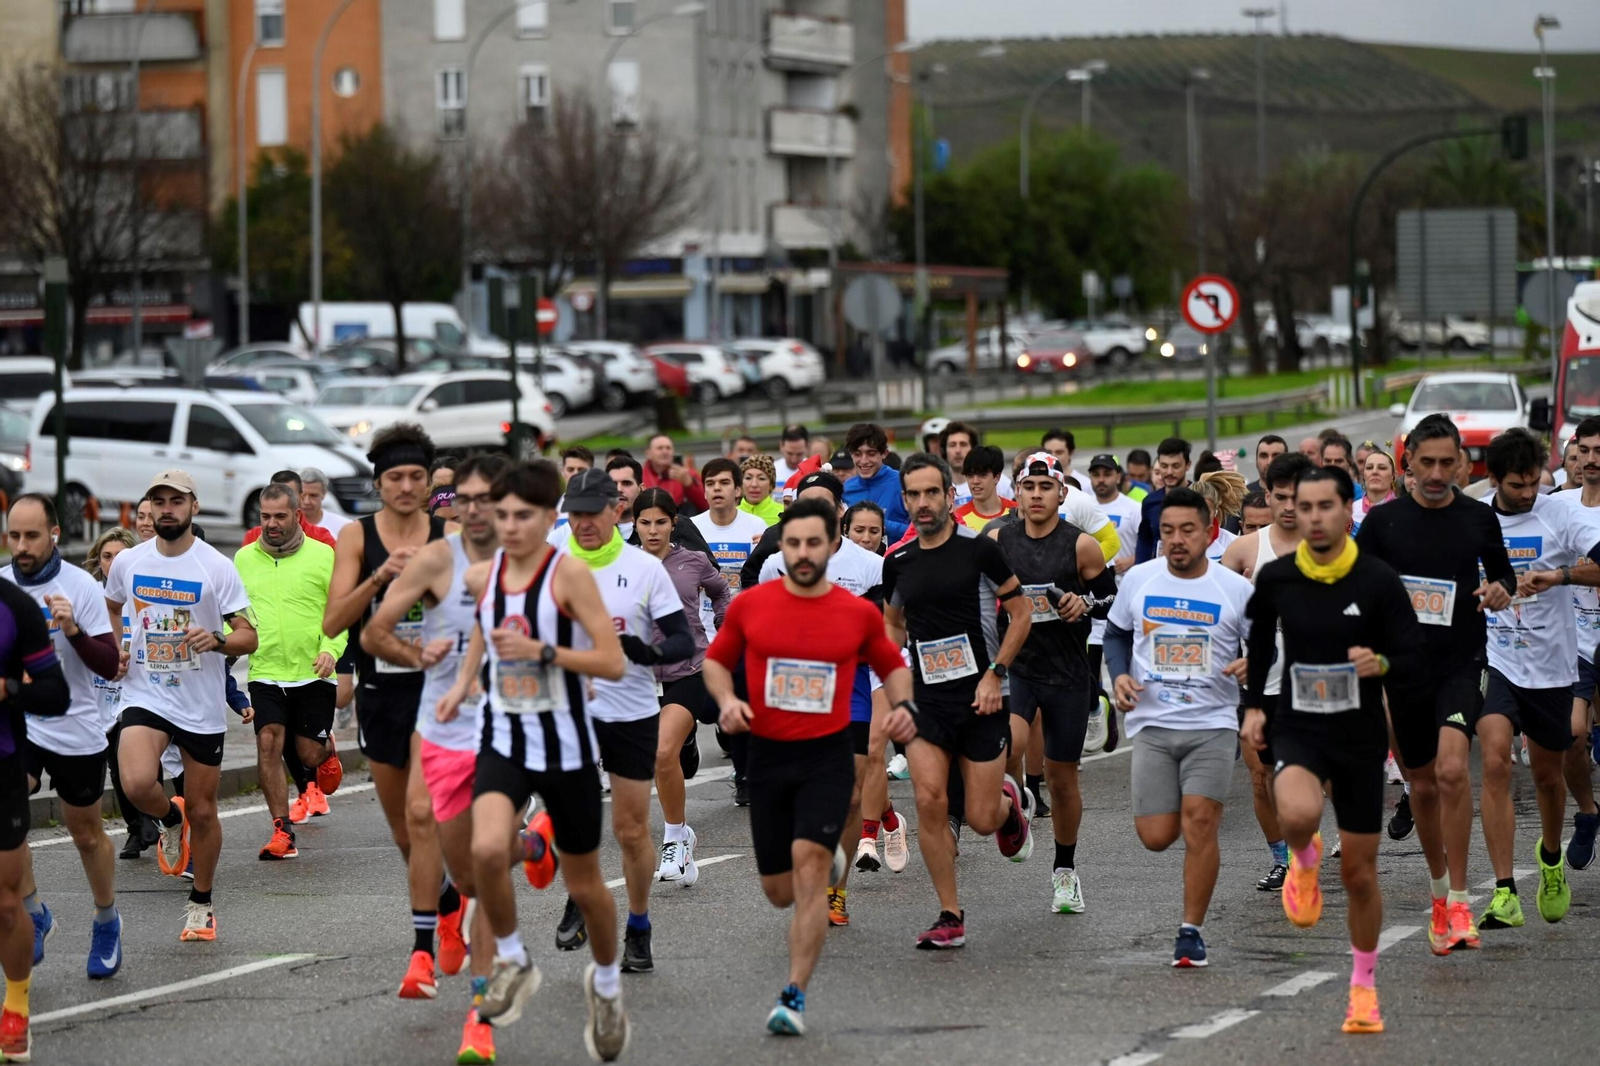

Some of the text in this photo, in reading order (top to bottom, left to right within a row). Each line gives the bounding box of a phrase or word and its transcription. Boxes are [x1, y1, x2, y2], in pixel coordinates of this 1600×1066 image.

[161, 580, 173, 588] 12
[136, 586, 196, 602] CORDOBARIA
[1408, 590, 1444, 613] 60
[1174, 600, 1189, 608] 12
[1147, 607, 1214, 624] CORDOBARIA
[147, 643, 188, 661] 231
[924, 649, 965, 673] 342
[1155, 644, 1201, 664] 122
[773, 674, 824, 699] 135
[1313, 679, 1326, 700] 1
